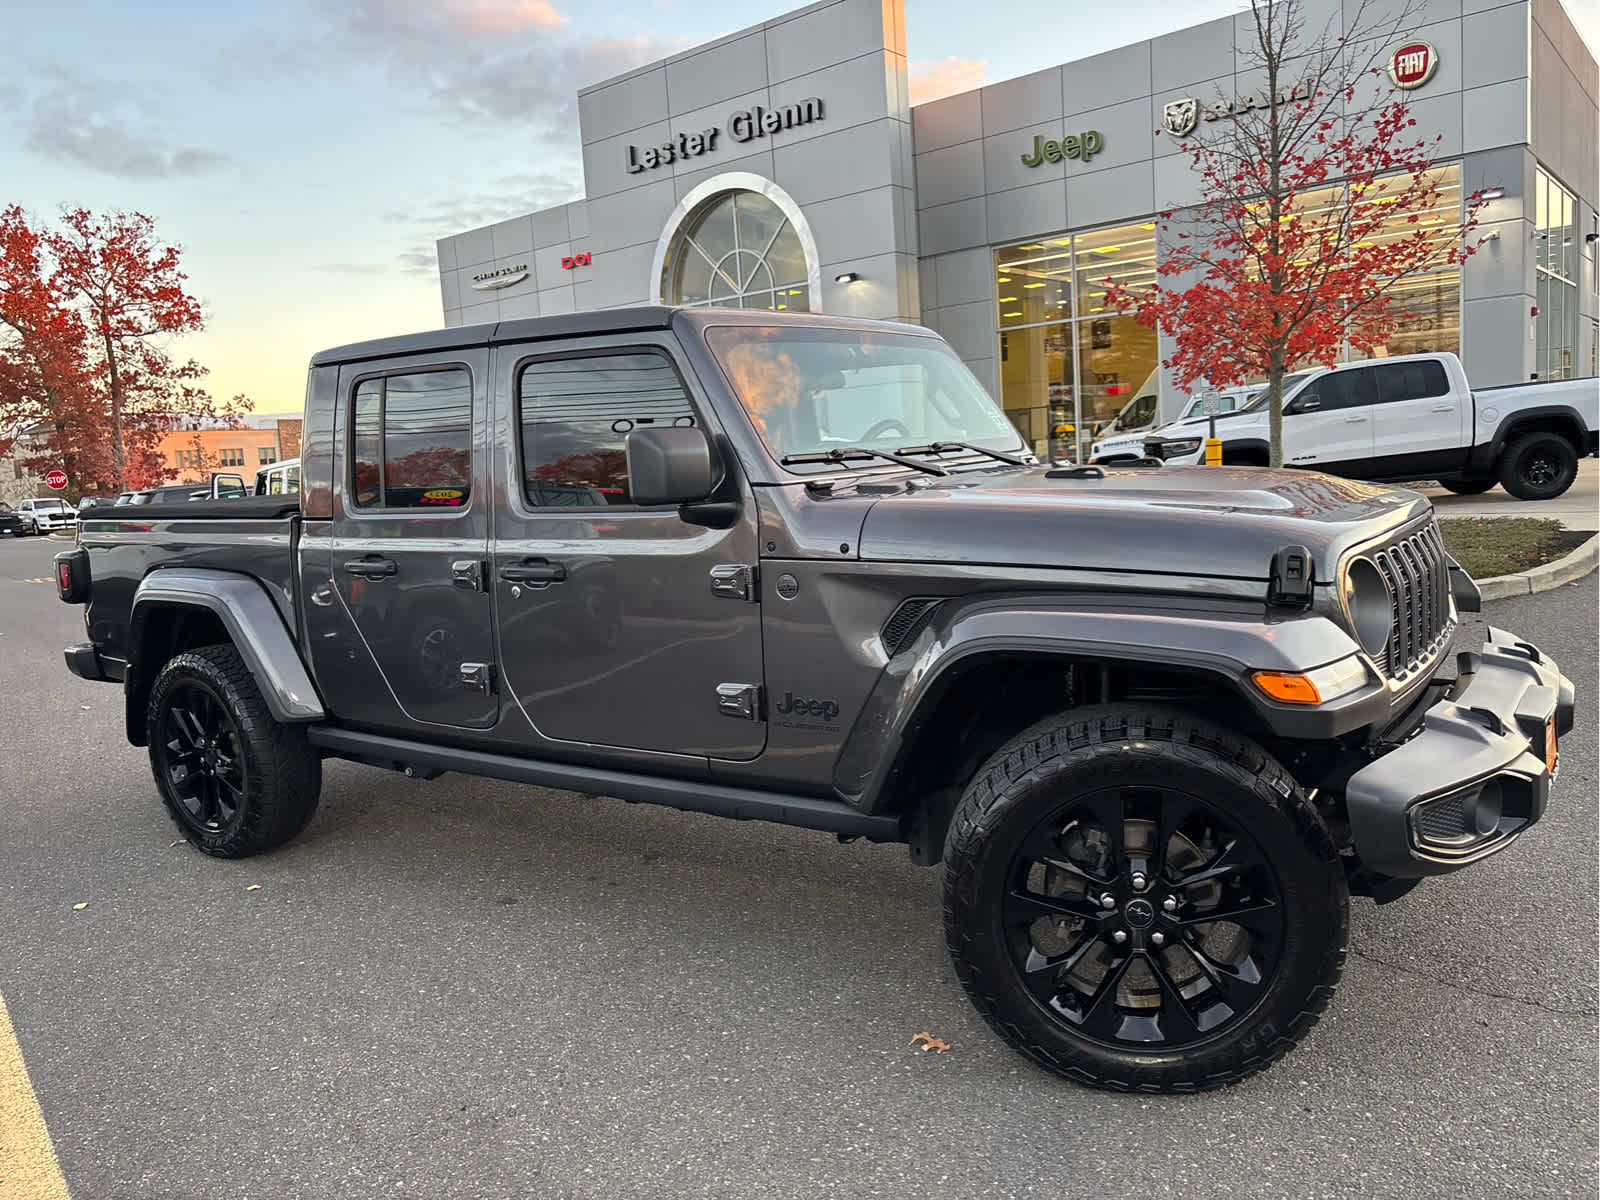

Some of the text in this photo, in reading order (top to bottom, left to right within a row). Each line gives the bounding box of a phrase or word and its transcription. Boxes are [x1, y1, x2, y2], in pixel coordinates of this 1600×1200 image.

[1398, 50, 1427, 77] FIAT
[1204, 78, 1311, 122] RAM
[625, 97, 825, 174] Lester Glenn
[1020, 129, 1102, 168] Jeep
[47, 475, 66, 485] STOP
[776, 690, 840, 721] Jeep
